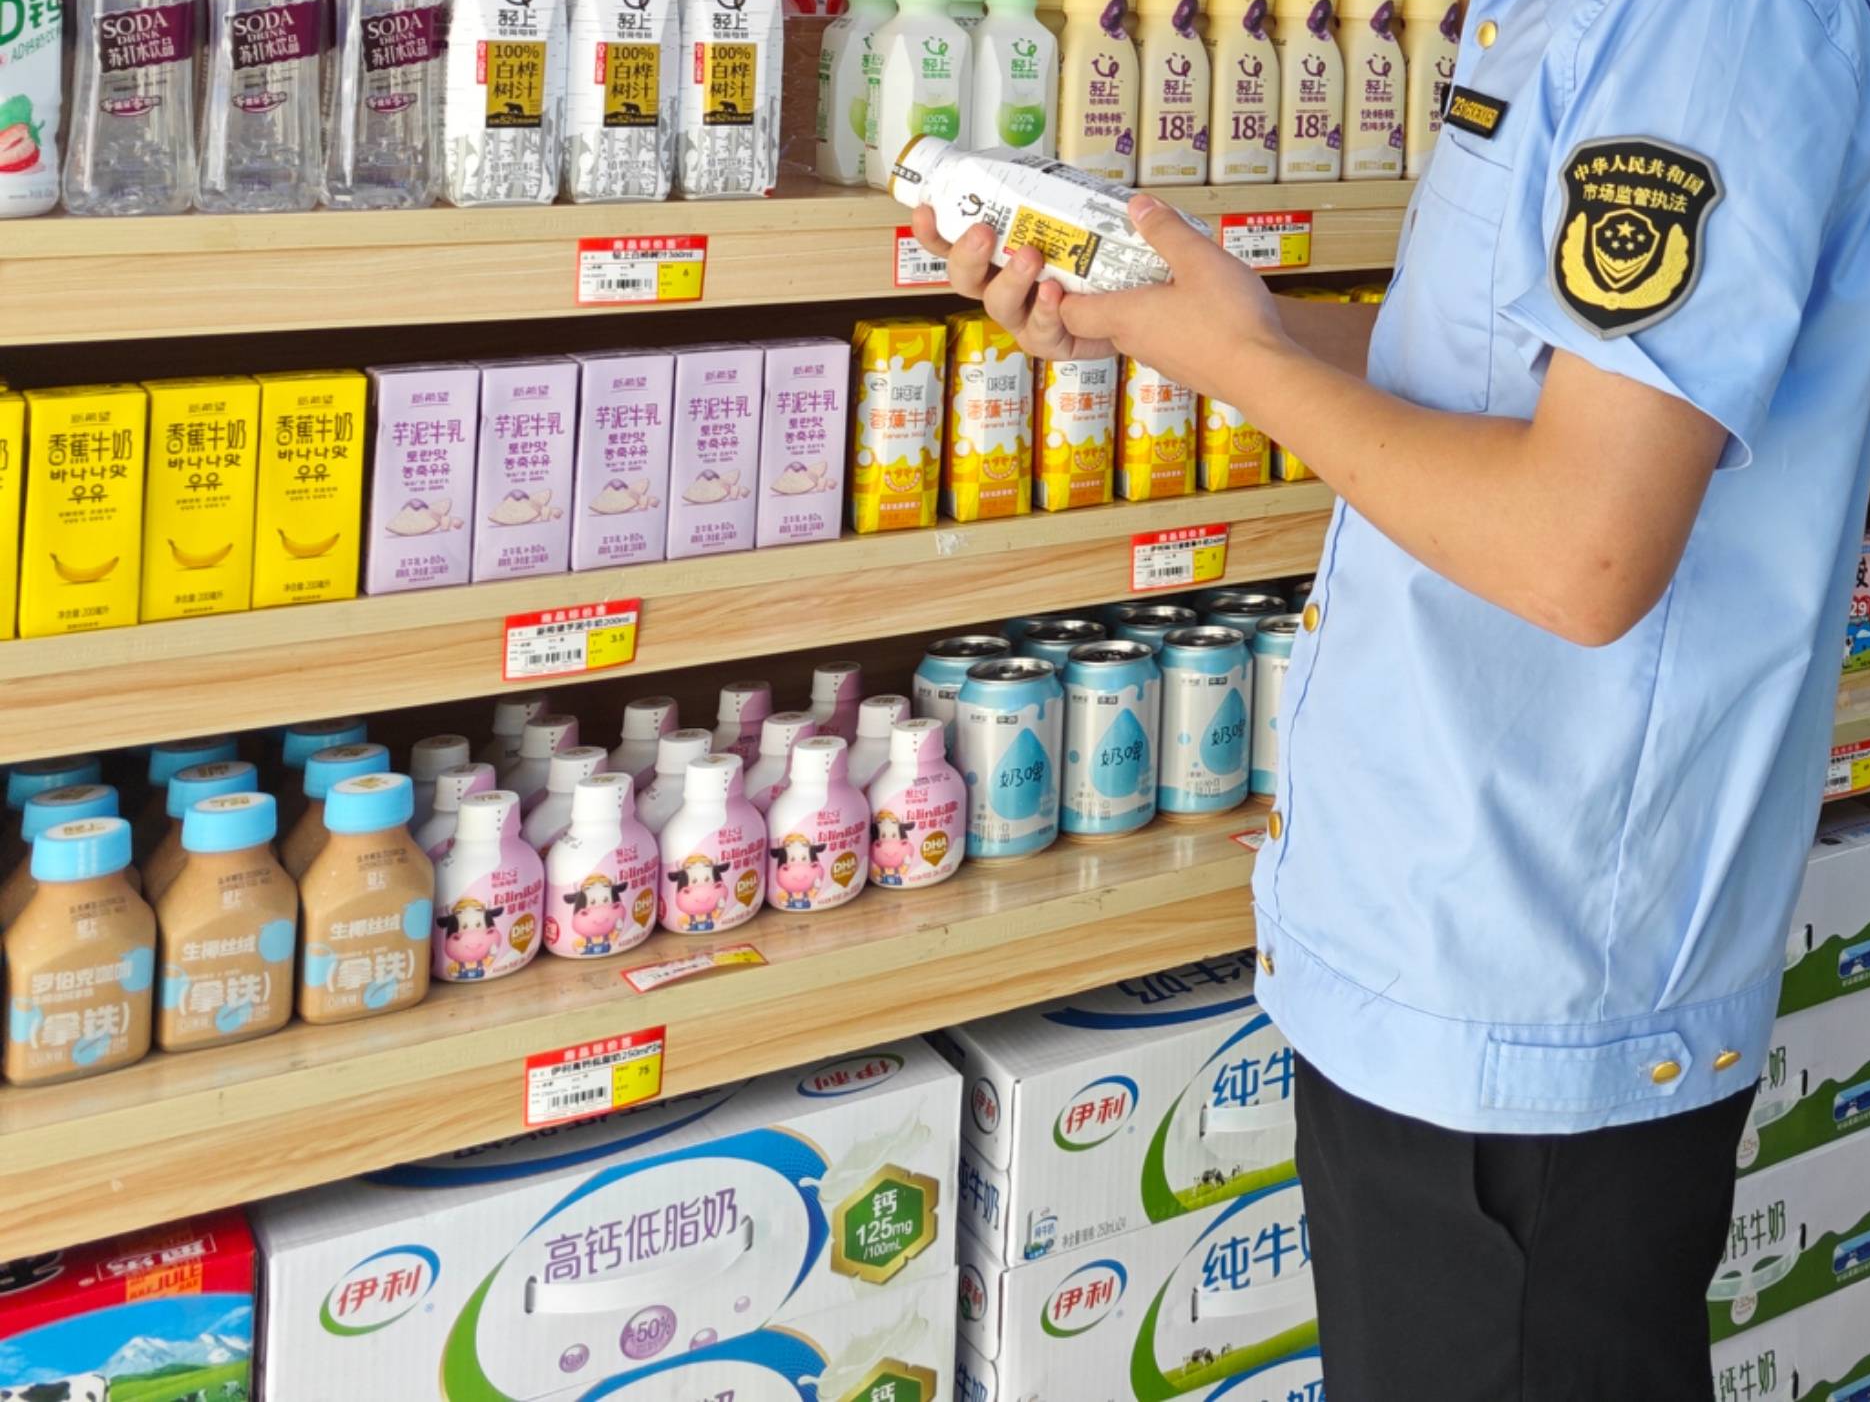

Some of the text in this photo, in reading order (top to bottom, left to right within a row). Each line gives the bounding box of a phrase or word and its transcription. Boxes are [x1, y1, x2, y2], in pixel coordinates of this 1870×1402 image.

[101, 12, 168, 37] SODA
[233, 10, 294, 35] SODA
[367, 12, 425, 40] SODA
[618, 13, 653, 30] 轻上
[116, 28, 157, 46] DRINK
[108, 37, 176, 68] 苏打水饮品
[239, 35, 301, 65] 苏打水饮品
[495, 44, 540, 59] 100%
[613, 46, 654, 61] 100%
[711, 46, 751, 60] 100%
[496, 61, 539, 80] 白桦
[613, 62, 654, 80] 白桦
[711, 62, 751, 79] 白桦
[494, 81, 537, 99] 树汁
[612, 81, 651, 98] 树汁
[710, 81, 747, 98] 树汁
[1089, 80, 1120, 98] 轻上
[1164, 80, 1192, 96] 轻上
[1158, 115, 1185, 140] 18
[1573, 153, 1704, 197] 中华人民共和国
[1582, 182, 1688, 215] 市场监管执法
[688, 396, 752, 421] 芋泥牛乳
[776, 389, 839, 414] 芋泥牛乳
[494, 411, 564, 438] 芋泥牛乳
[595, 403, 662, 429] 芋泥牛乳
[165, 418, 246, 456] 香蕉牛奶
[275, 412, 354, 448] 香蕉牛奶
[607, 432, 645, 446] 토란맛
[48, 429, 133, 467] 香蕉牛奶
[406, 447, 449, 463] 토란맛
[508, 440, 548, 455] 토란맛
[50, 463, 128, 484] 바나나맛
[610, 634, 625, 643] 3.5
[1100, 740, 1144, 768] 奶啤
[999, 760, 1044, 790] 奶啤
[922, 837, 947, 853] DHA
[832, 859, 858, 874] DHA
[329, 913, 401, 941] 生椰丝绒
[181, 933, 257, 963] 生椰丝绒
[638, 1066, 650, 1075] 75
[1065, 1092, 1126, 1134] 伊利
[872, 1191, 899, 1217] 钙
[543, 1186, 738, 1285] 高钙低脂奶
[855, 1219, 914, 1246] 125mg
[863, 1238, 904, 1261] /100mL
[336, 1264, 423, 1318] 伊利
[1051, 1274, 1114, 1318] 伊利
